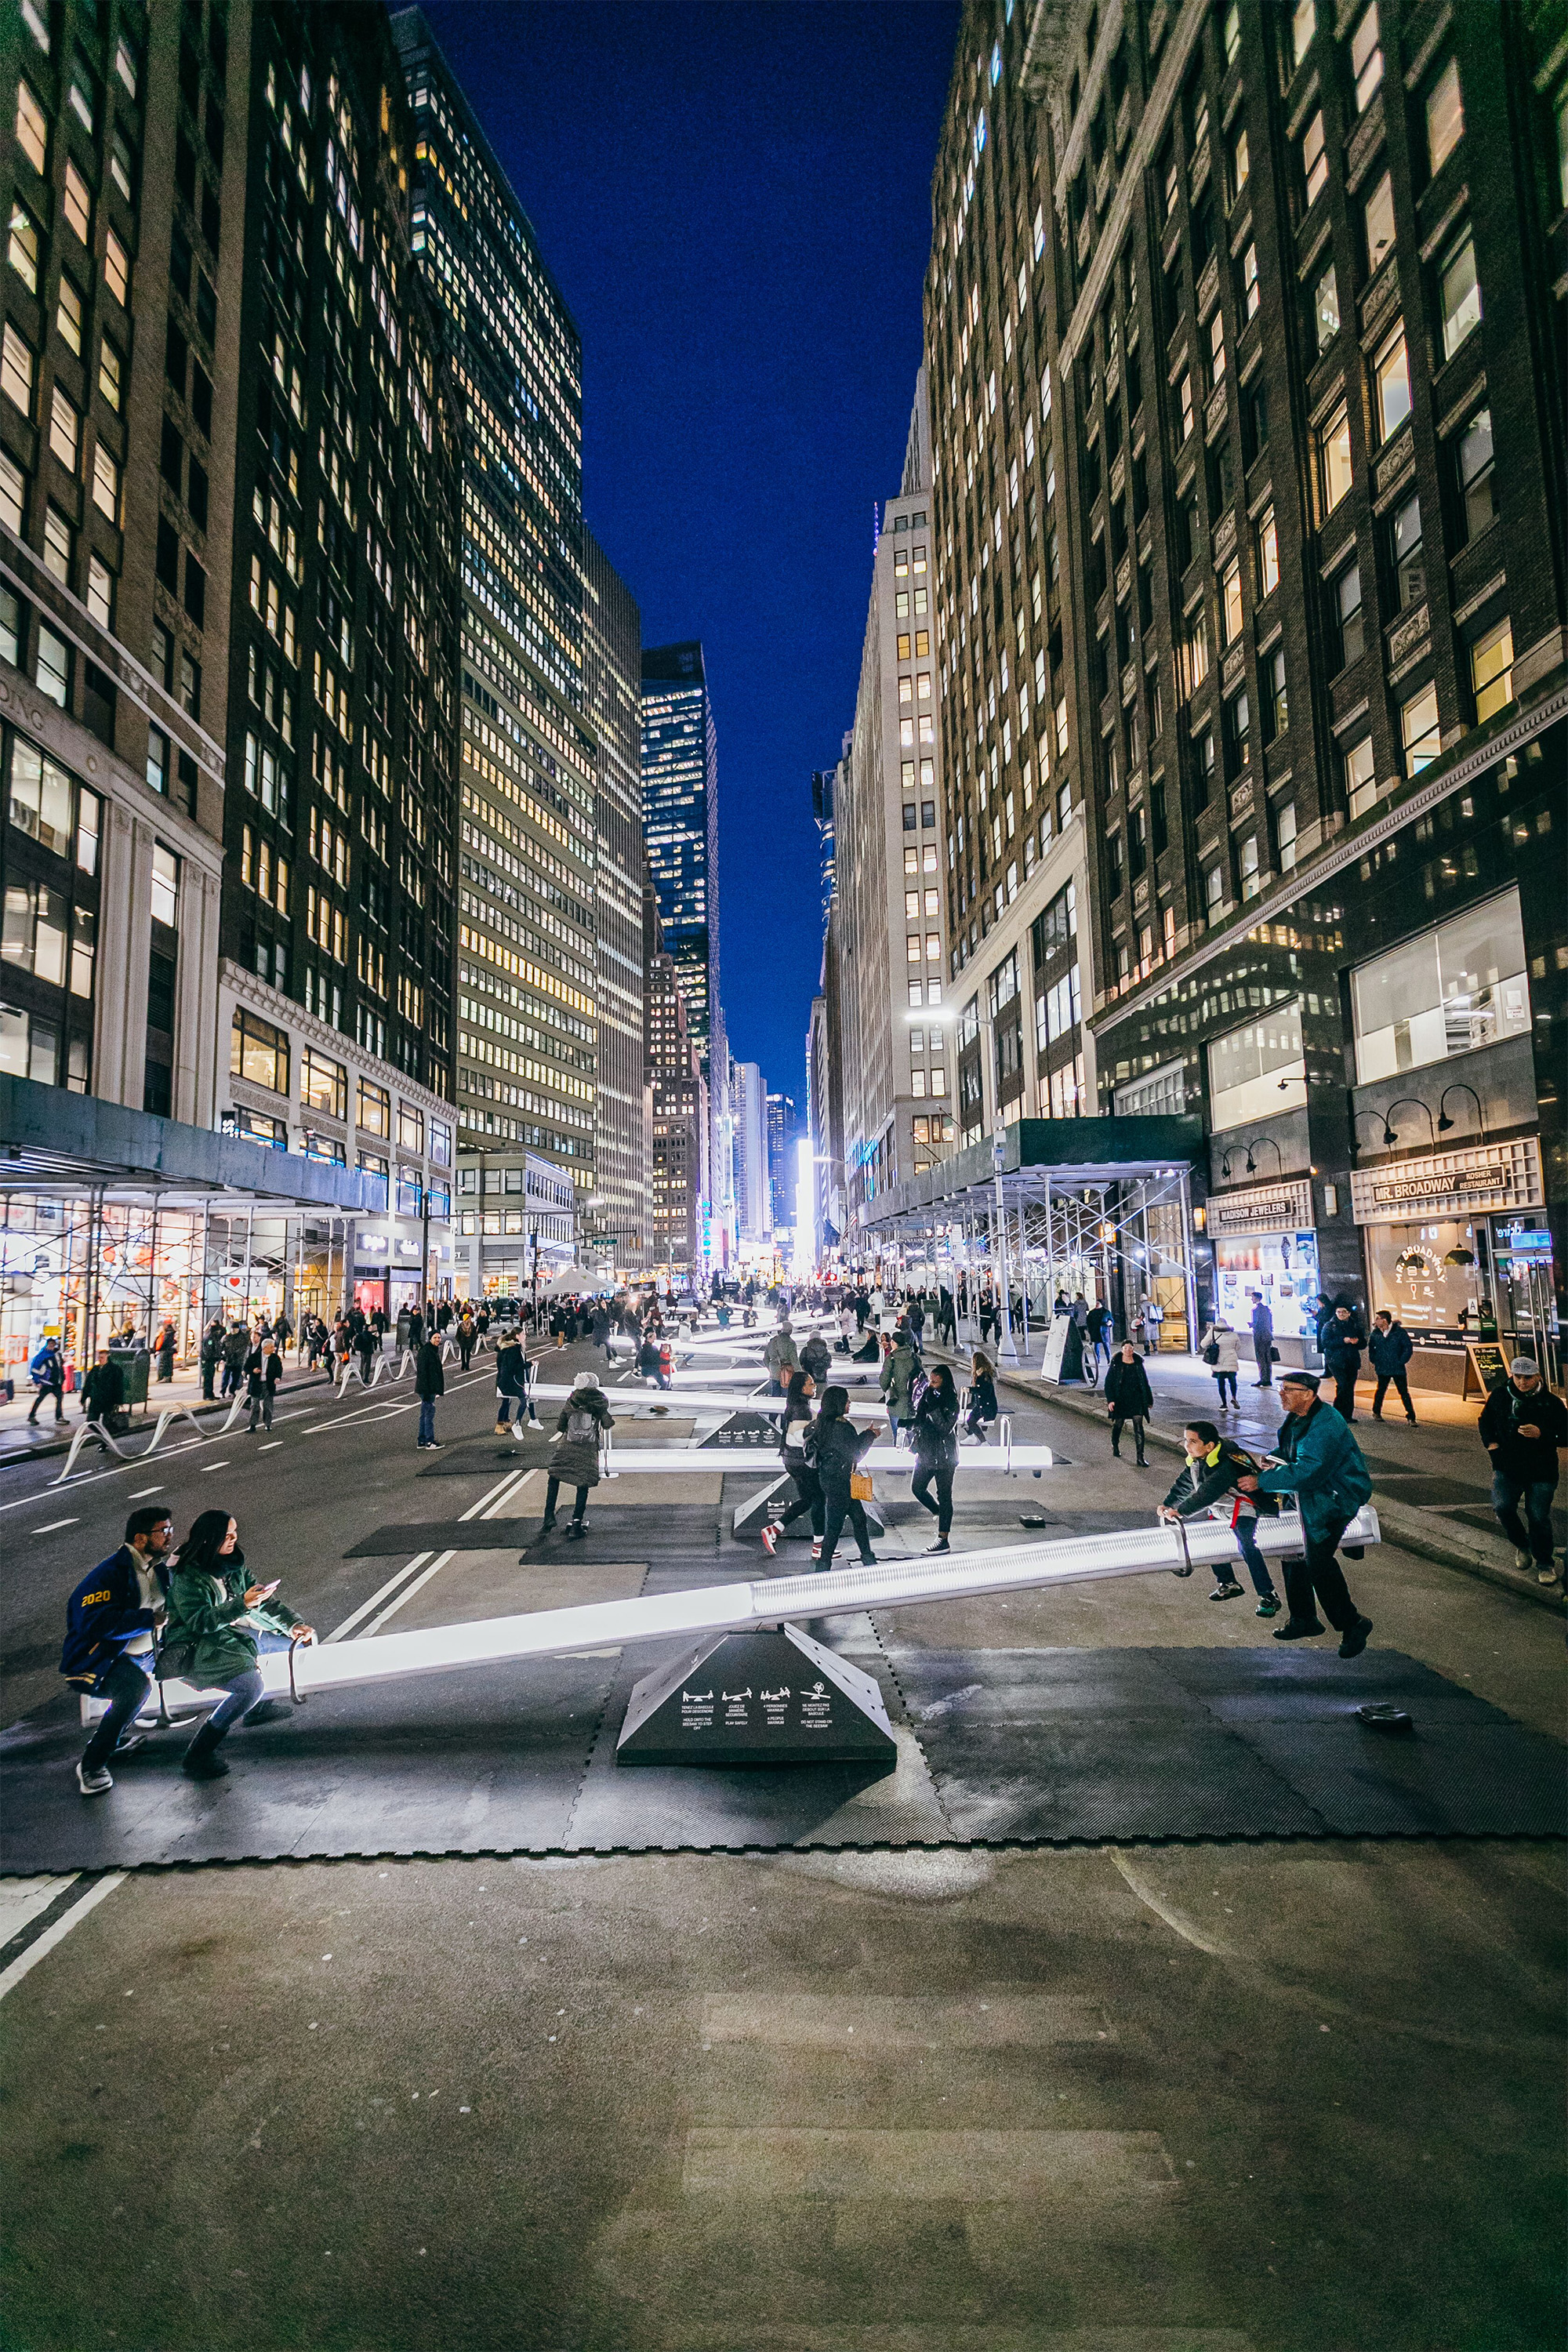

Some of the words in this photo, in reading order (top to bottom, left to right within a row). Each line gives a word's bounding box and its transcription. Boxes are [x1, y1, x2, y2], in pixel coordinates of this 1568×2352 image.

[1459, 1177, 1501, 1190] RESTAURANT
[1466, 1170, 1492, 1180] KOSHER
[1376, 1187, 1394, 1200] MR.
[1395, 1177, 1456, 1198] BROADWAY
[1221, 1207, 1249, 1221] MADISON
[1250, 1202, 1286, 1217] JEWELERS
[1396, 1262, 1406, 1283] MR.
[1401, 1245, 1448, 1283] BROADWAY
[1470, 1301, 1475, 1310] A
[82, 1590, 111, 1607] 2020
